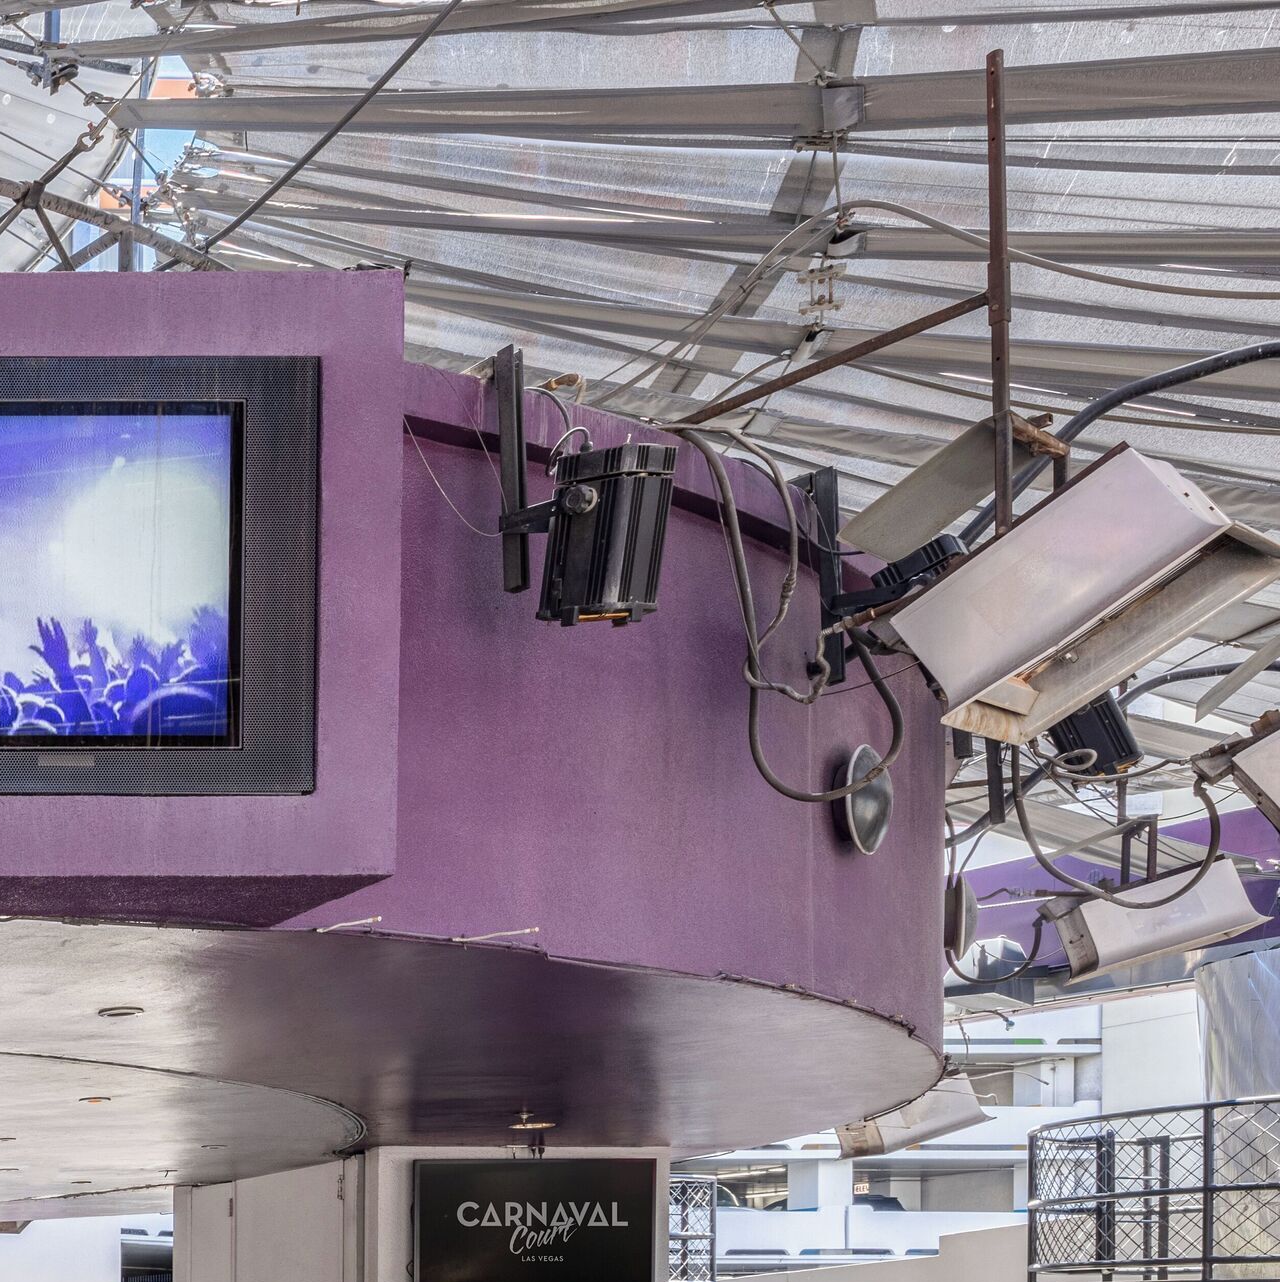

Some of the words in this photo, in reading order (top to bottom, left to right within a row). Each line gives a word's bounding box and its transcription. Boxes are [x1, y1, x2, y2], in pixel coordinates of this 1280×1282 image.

[456, 1201, 629, 1228] CARNAVAL
[509, 1216, 578, 1255] Court
[521, 1255, 536, 1263] LAS
[538, 1255, 564, 1263] VEGAS
